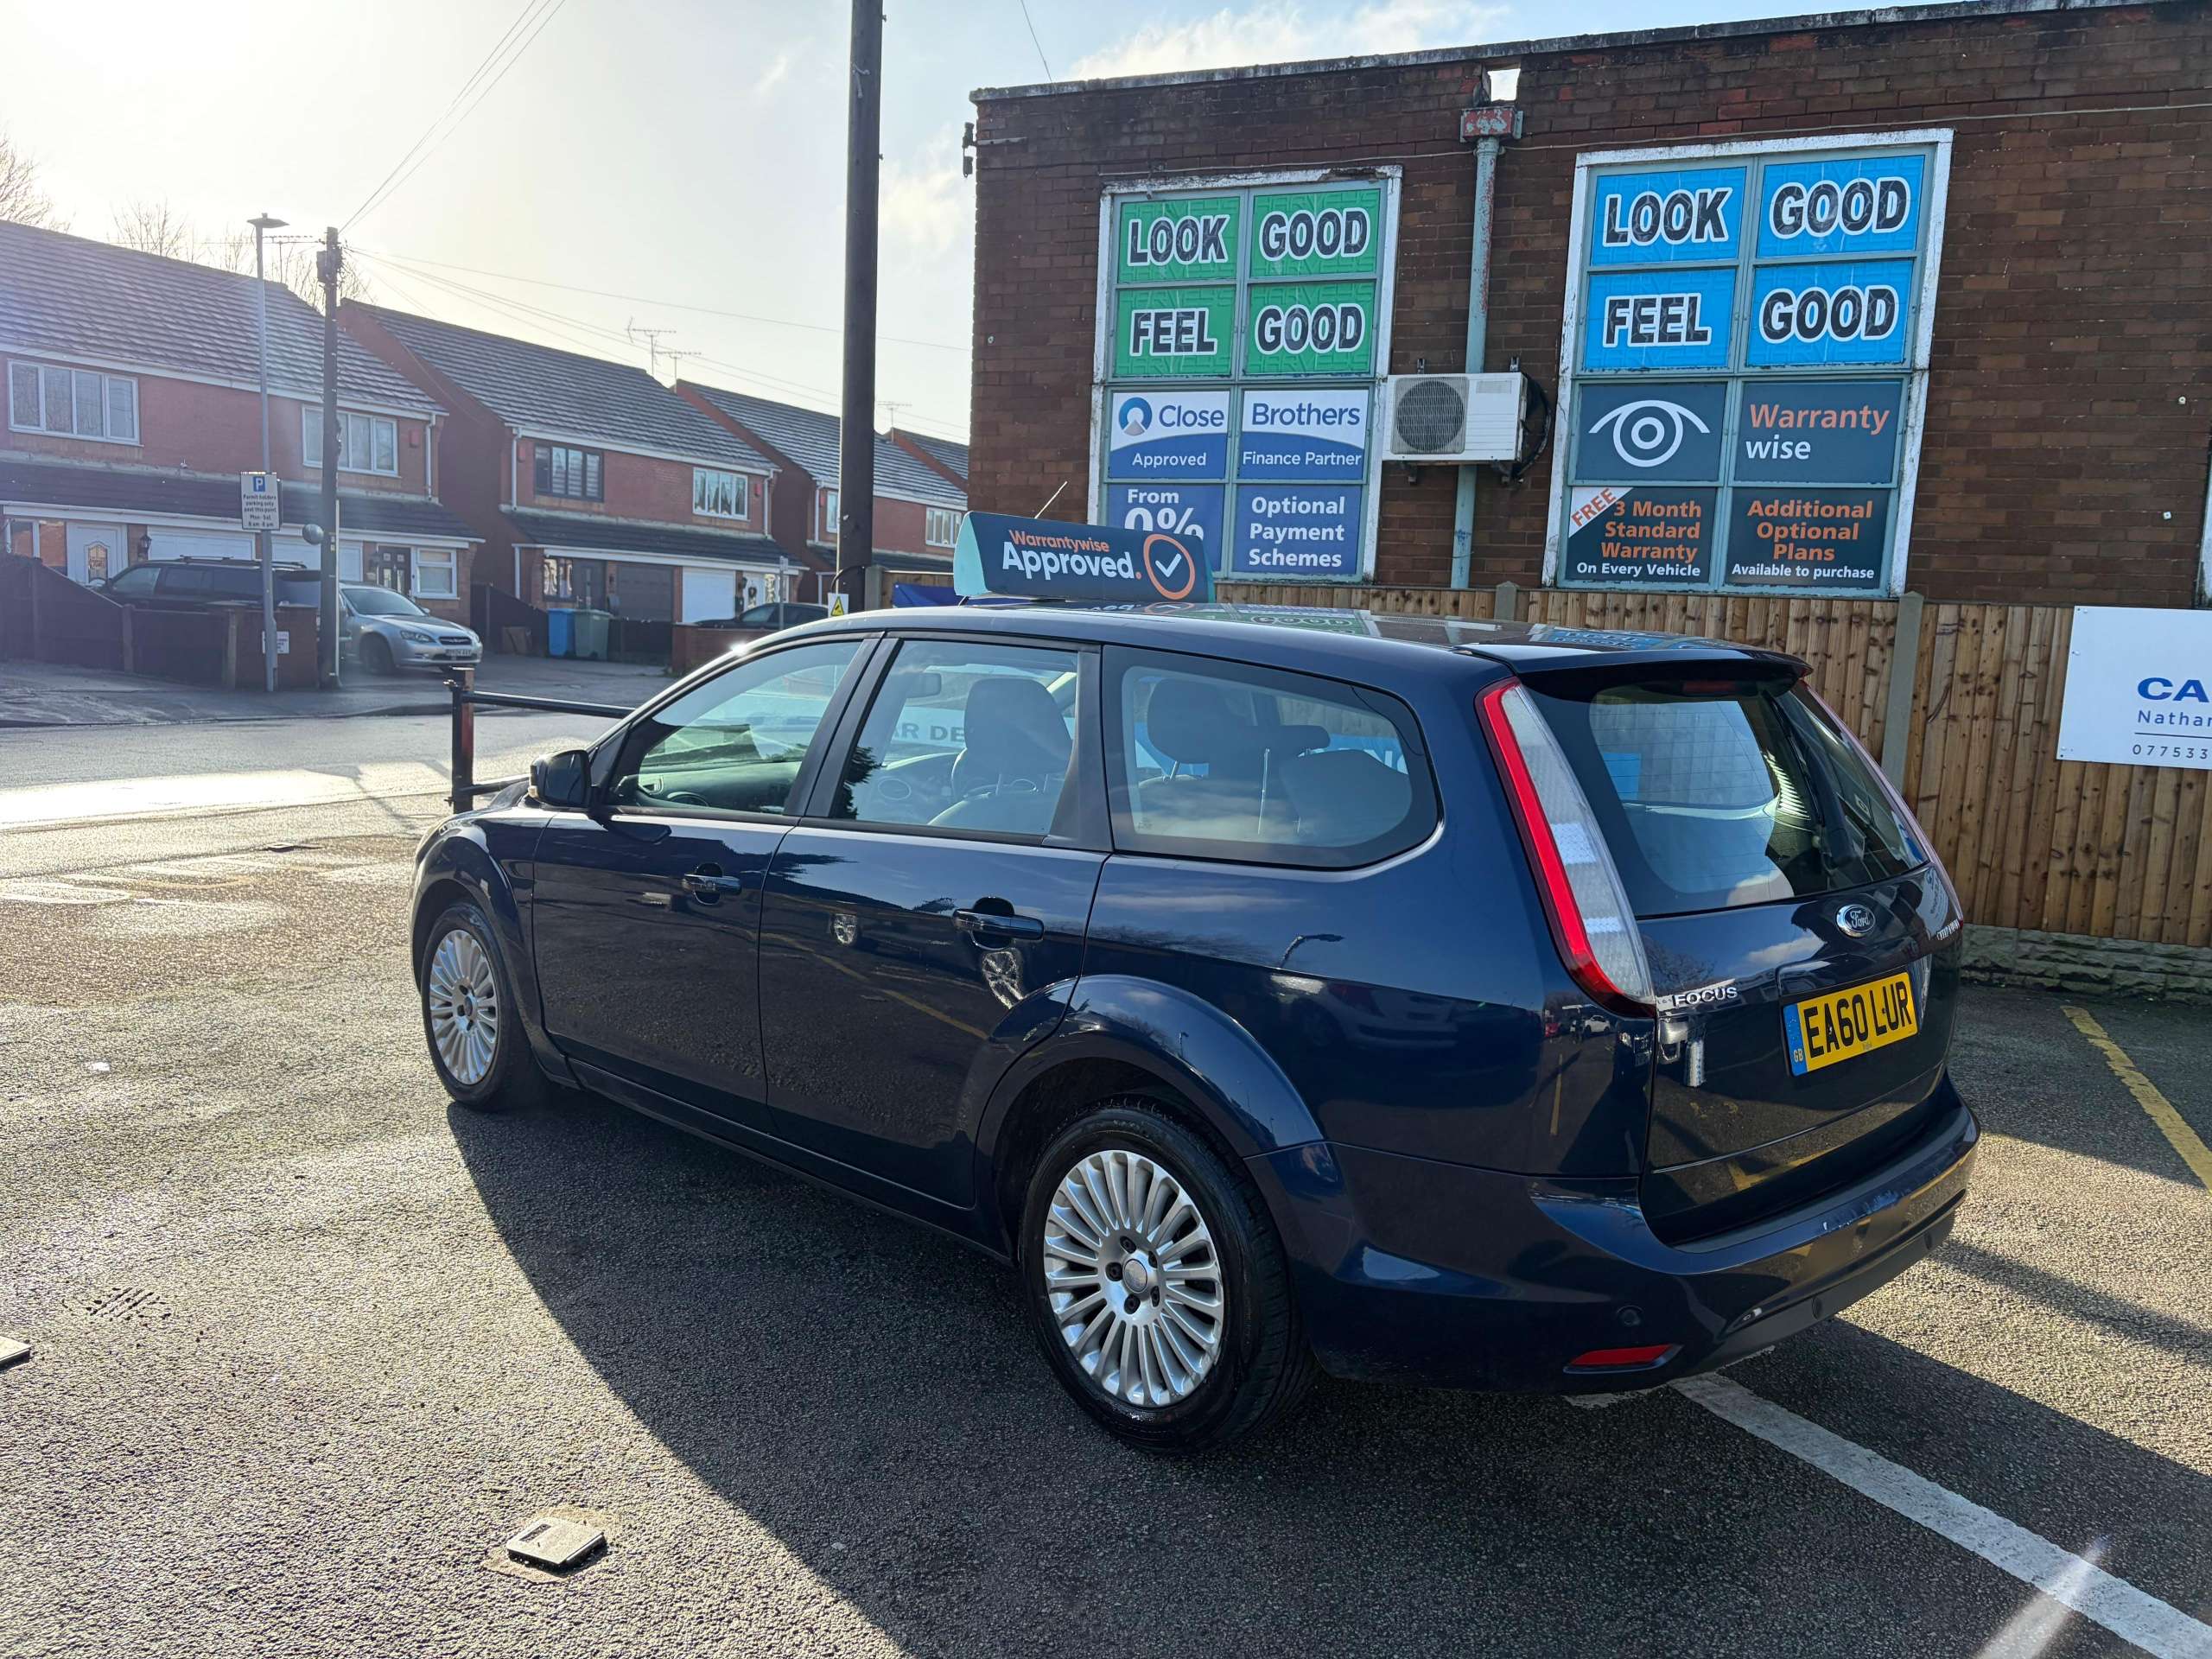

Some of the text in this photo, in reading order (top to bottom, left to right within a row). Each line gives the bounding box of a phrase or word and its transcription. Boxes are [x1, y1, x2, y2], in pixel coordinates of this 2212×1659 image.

[1603, 176, 1910, 247] LOOK GOOD
[1128, 207, 1371, 266] LOOK GOOD
[1603, 285, 1898, 347] FEEL GOOD
[1129, 303, 1365, 356] FEEL GOOD
[1159, 403, 1360, 427] Close Brothers
[1750, 404, 1890, 435] Warranty
[1745, 435, 1811, 459] wise
[1132, 451, 1363, 468] Approved Finance Partner
[256, 477, 264, 491] P
[1128, 489, 1179, 504] From
[1571, 487, 1617, 526] FREE
[1252, 496, 1344, 518] Optional
[1614, 500, 1701, 518] 3 Month
[1747, 499, 1873, 518] Additional
[1249, 523, 1344, 543] Payment
[1605, 521, 1700, 539] Standard
[1757, 522, 1859, 543] Optional
[1008, 530, 1109, 553] Warrantywise
[1249, 549, 1342, 568] Schemes
[1601, 542, 1698, 563] Warranty
[1773, 543, 1835, 561] Plans
[1577, 563, 1700, 577] On Every Vehicle
[1732, 563, 1875, 580] Available to purchase
[2133, 744, 2209, 760] 077533
[1850, 910, 1870, 928] Ford
[1673, 987, 1738, 1007] FOCUS
[1803, 981, 1912, 1058] EA60 LUR
[1793, 1048, 1804, 1063] GB
